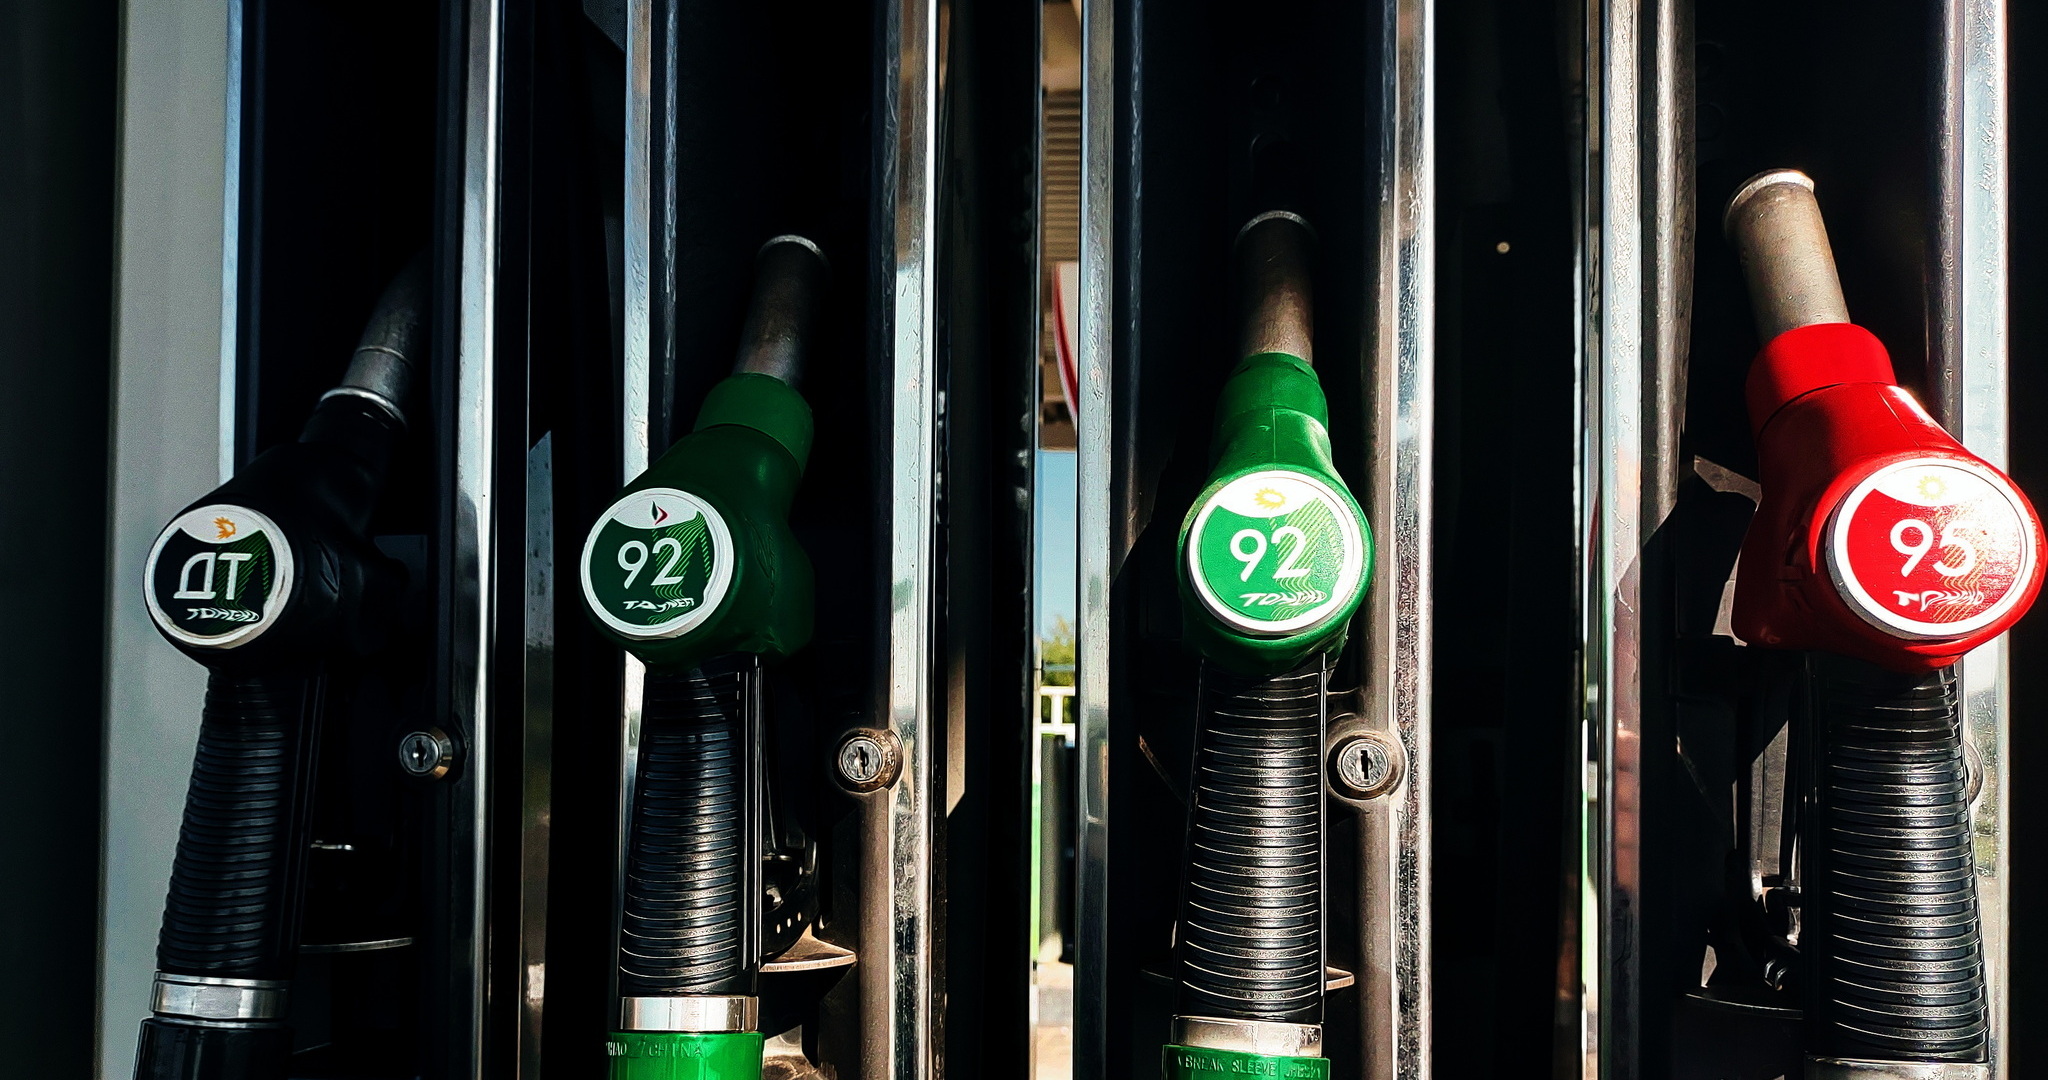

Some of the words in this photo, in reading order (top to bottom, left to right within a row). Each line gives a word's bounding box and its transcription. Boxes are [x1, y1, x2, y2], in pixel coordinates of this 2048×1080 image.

[617, 537, 685, 590] 92
[1230, 525, 1311, 583] 92
[1890, 518, 1976, 578] 95
[173, 551, 253, 600] ДТ
[1185, 1054, 1224, 1073] BREAK
[1231, 1059, 1277, 1077] SLEEVE
